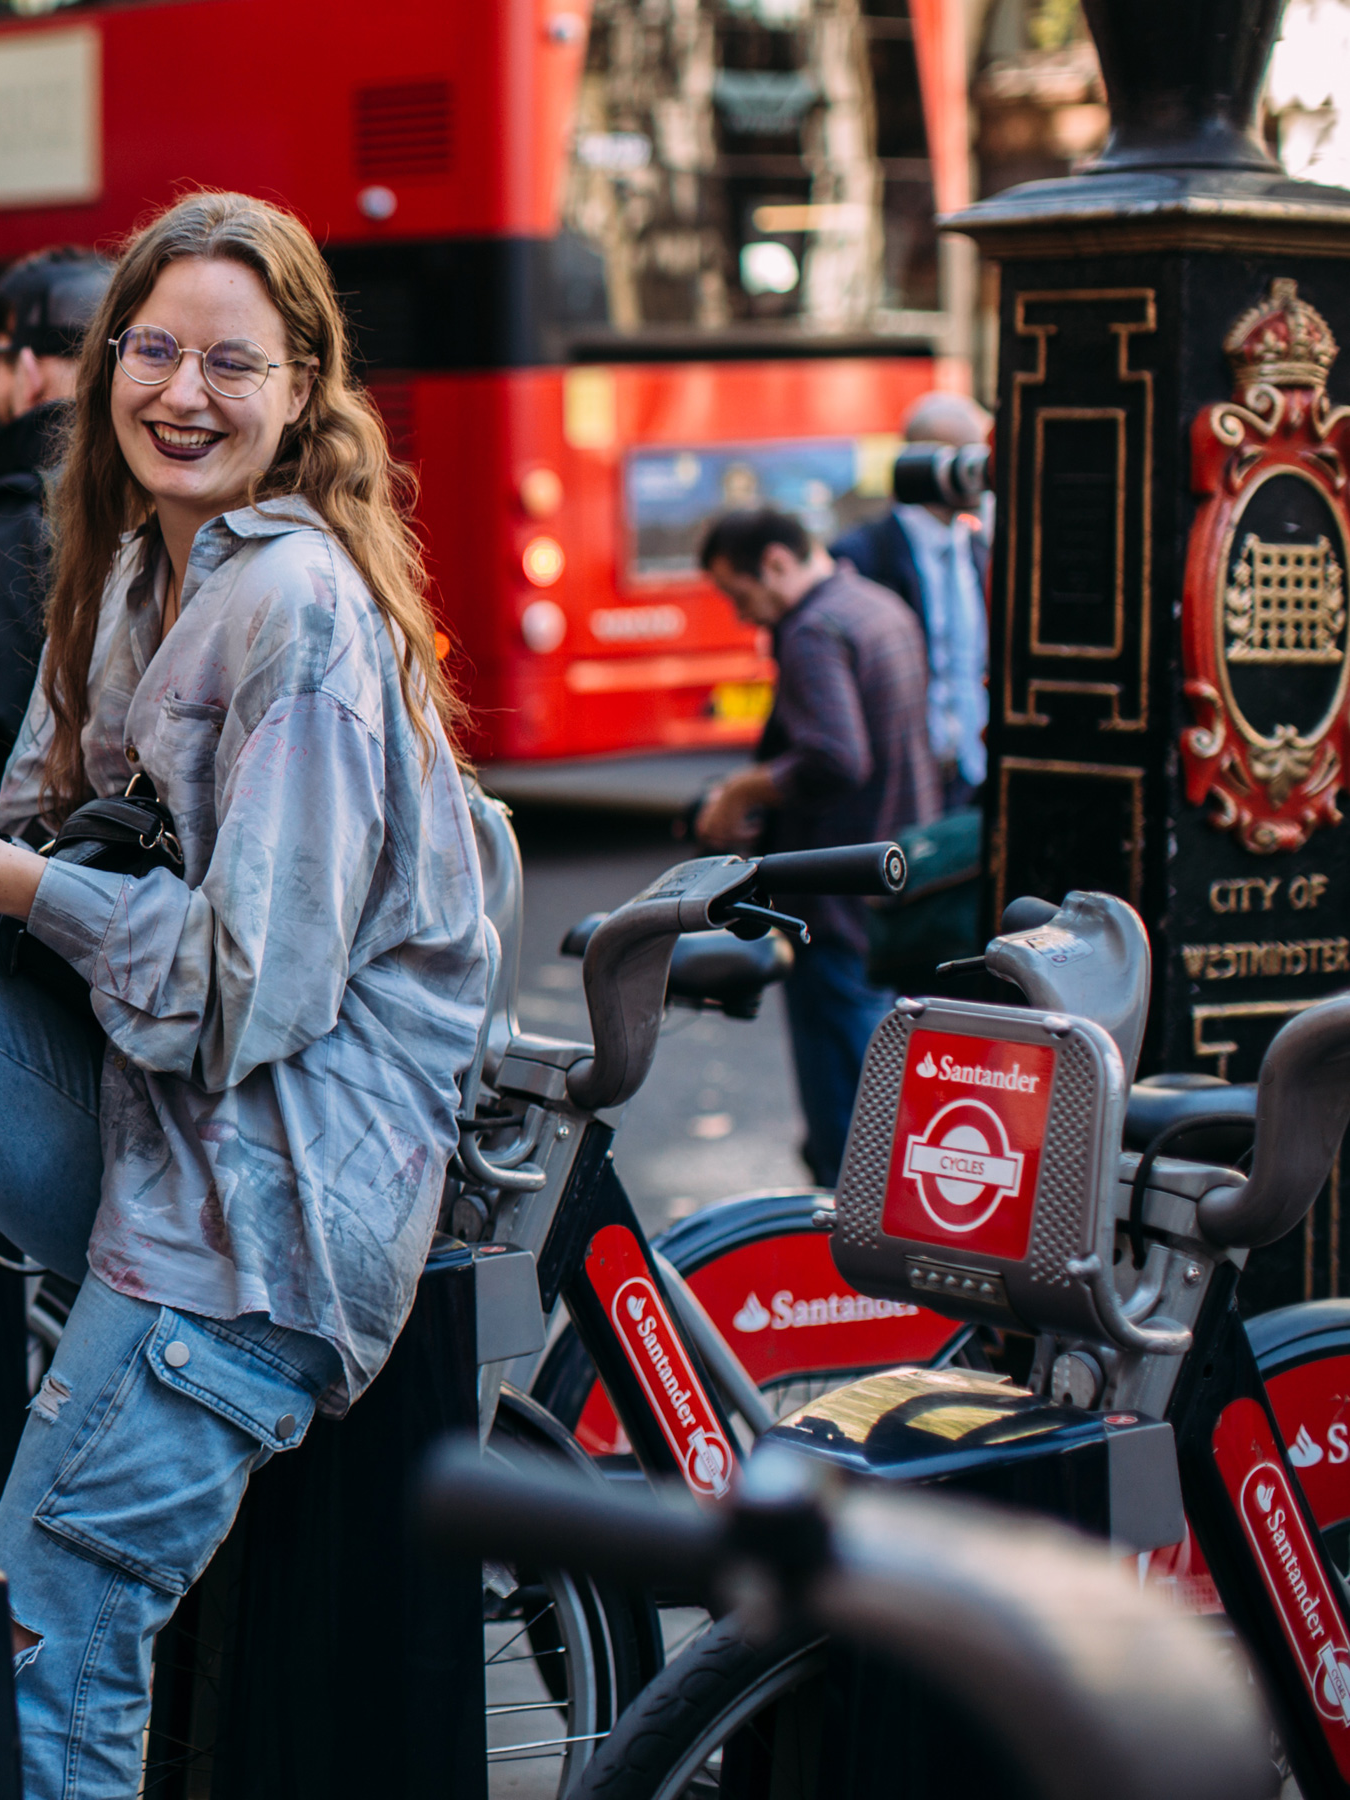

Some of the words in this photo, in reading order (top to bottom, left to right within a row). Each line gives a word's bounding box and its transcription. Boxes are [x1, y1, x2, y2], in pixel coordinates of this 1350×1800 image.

[1210, 876, 1282, 913] CITY
[1289, 873, 1329, 910] OF
[1182, 937, 1349, 979] WESTMINSTER
[938, 1055, 1040, 1093] Santander
[940, 1156, 985, 1175] CYCLES
[637, 1315, 697, 1429] Santander
[1266, 1508, 1325, 1641] Santander
[1331, 1668, 1347, 1700] CYCLES
